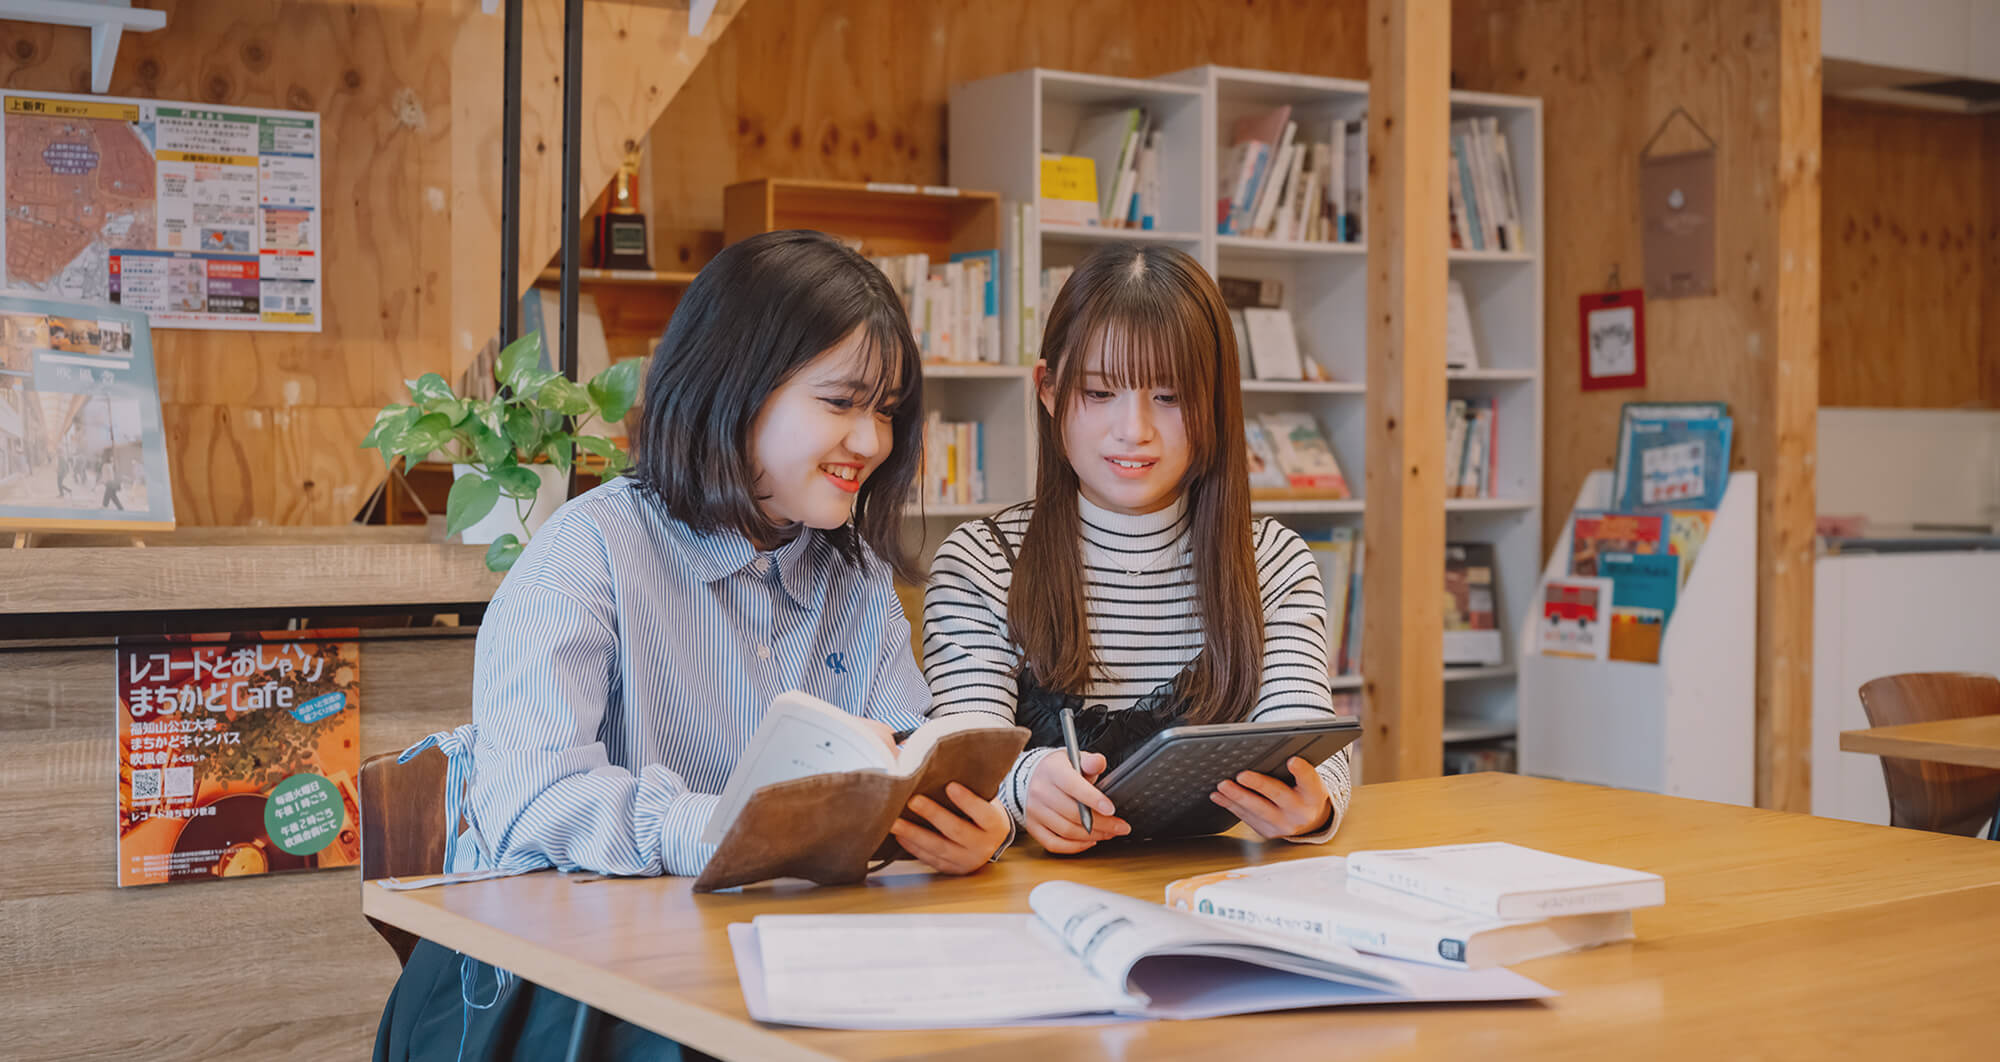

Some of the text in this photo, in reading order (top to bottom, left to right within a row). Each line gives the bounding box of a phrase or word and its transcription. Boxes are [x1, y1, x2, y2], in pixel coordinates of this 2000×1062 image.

[130, 681, 293, 717] まちかどCafe
[130, 718, 217, 736] 福知山公立大学
[130, 732, 241, 751] まちかどキャンパス
